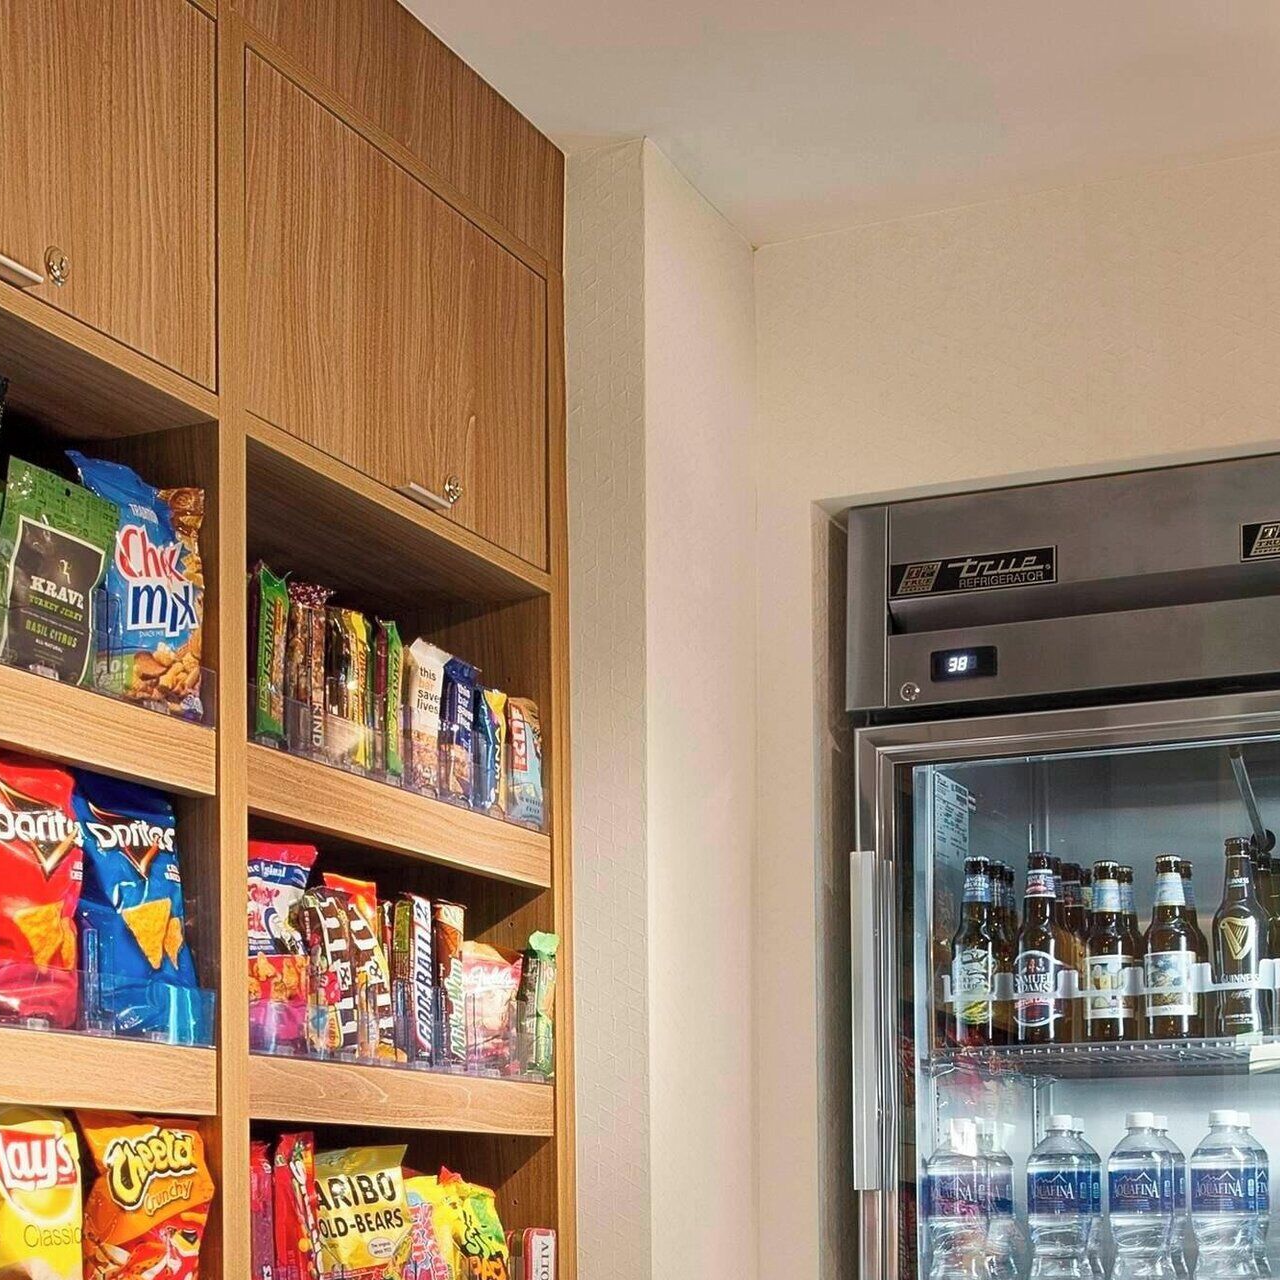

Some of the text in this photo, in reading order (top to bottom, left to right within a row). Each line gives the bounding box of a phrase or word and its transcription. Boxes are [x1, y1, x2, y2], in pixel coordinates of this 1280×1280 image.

[947, 556, 1044, 578] true
[958, 570, 1044, 589] REFRIGERATOR
[29, 575, 85, 610] KRAVE
[25, 619, 78, 649] BASIL CITRUS
[419, 666, 437, 682] this
[947, 656, 968, 673] 38
[312, 702, 323, 747] KIND
[86, 820, 176, 852] Doritos
[316, 1171, 397, 1213] ARIBO
[1195, 1179, 1244, 1198] AQUAFINA
[318, 1208, 405, 1240] OLD-BEARS
